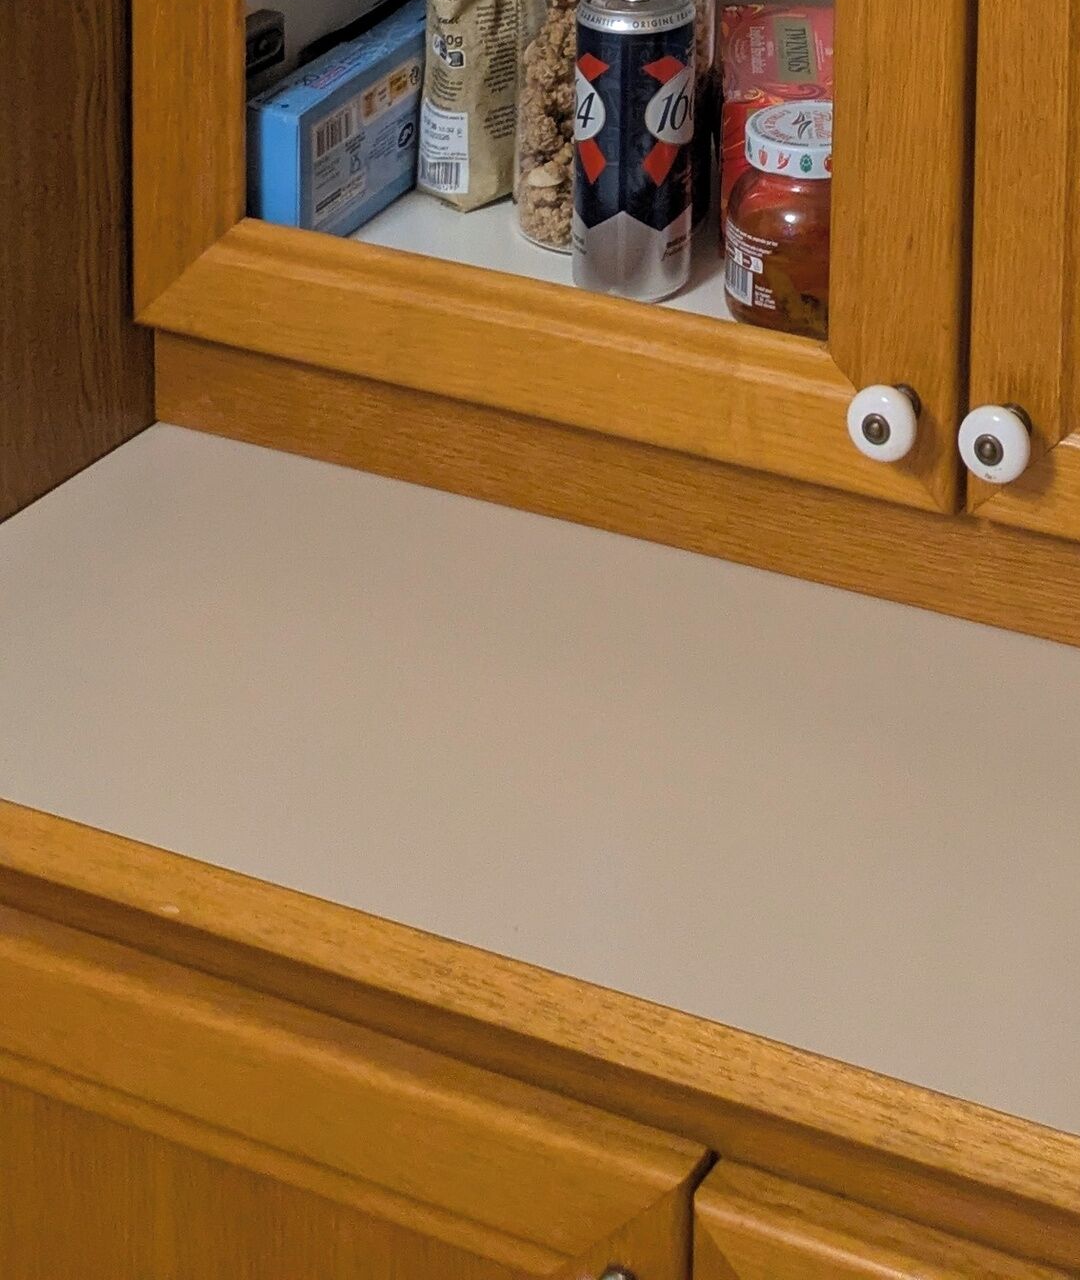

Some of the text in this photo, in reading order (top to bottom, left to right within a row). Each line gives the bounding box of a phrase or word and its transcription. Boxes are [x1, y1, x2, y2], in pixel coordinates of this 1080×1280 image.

[632, 17, 673, 29] ORIGINE
[785, 27, 810, 74] TWININGS
[657, 77, 693, 134] 16
